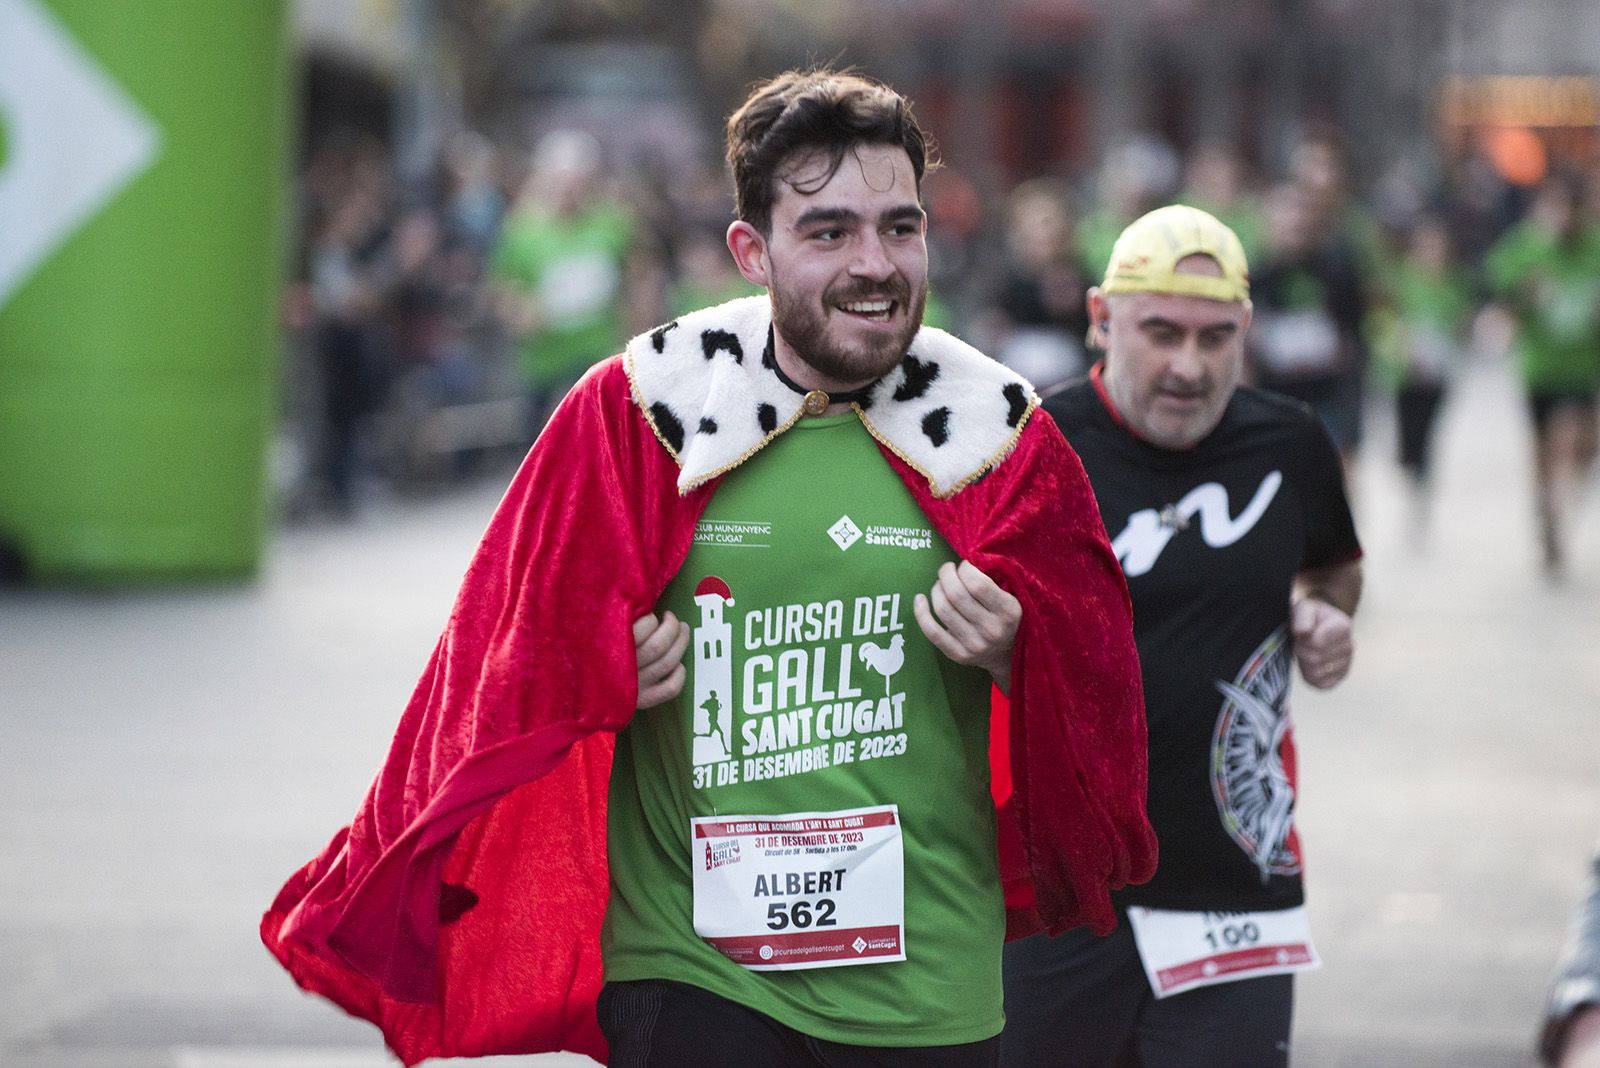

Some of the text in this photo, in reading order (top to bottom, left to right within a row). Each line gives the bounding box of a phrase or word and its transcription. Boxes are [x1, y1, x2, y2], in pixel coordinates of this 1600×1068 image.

[694, 533, 743, 543] SANT CUGAT
[695, 523, 772, 534] CLUB MUNTANYENC
[866, 525, 932, 538] AJUNTAMENT DE
[865, 533, 932, 550] SantCugat
[744, 593, 904, 651] CURSA DEL
[742, 643, 862, 715] GALL
[692, 733, 908, 790] 31 DE DESEMBRE DE 2023
[726, 824, 735, 833] LA
[736, 823, 758, 833] CURSA
[828, 818, 844, 829] SANT
[755, 832, 864, 848] 31 DE DESEMBRE DE 2023
[753, 869, 847, 898] ALBERT
[766, 898, 837, 930] 562
[1205, 922, 1260, 949] 100
